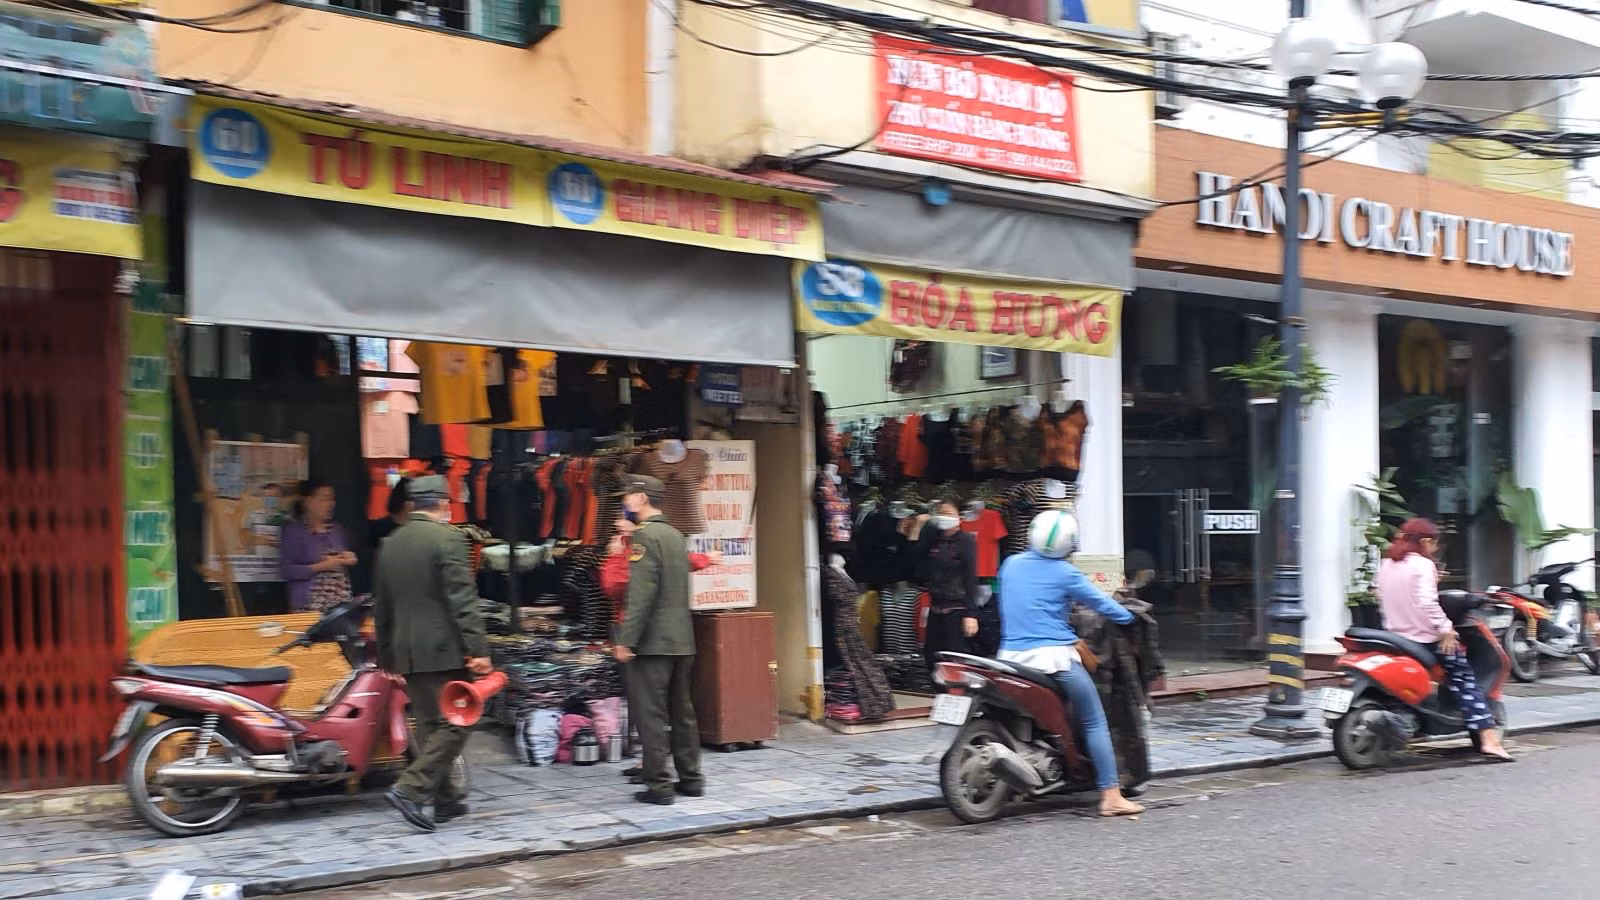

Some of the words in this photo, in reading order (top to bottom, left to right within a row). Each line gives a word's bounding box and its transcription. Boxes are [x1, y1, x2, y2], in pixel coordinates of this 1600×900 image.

[978, 74, 1033, 111] NAM
[303, 130, 374, 189] TÚ
[389, 147, 512, 209] LINH
[612, 179, 721, 234] GIANG
[1340, 197, 1464, 261] CRAFT
[1464, 218, 1574, 277] HOUSE
[1204, 514, 1257, 529] PUSH
